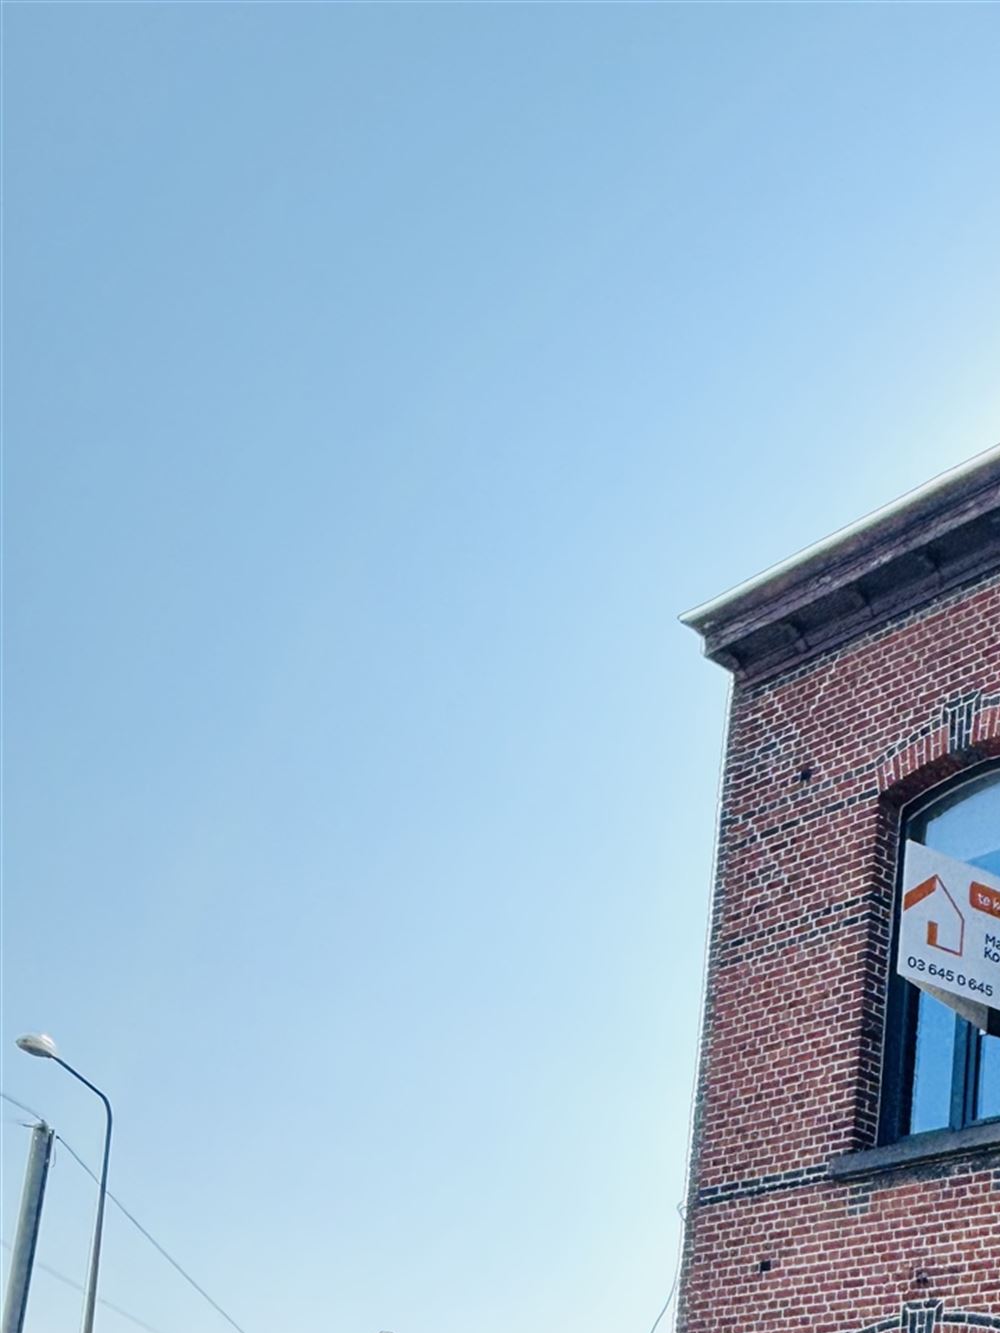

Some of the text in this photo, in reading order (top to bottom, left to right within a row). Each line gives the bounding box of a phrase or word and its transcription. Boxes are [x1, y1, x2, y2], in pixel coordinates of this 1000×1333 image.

[978, 893, 991, 906] te
[907, 956, 994, 997] 03 645 0 645
